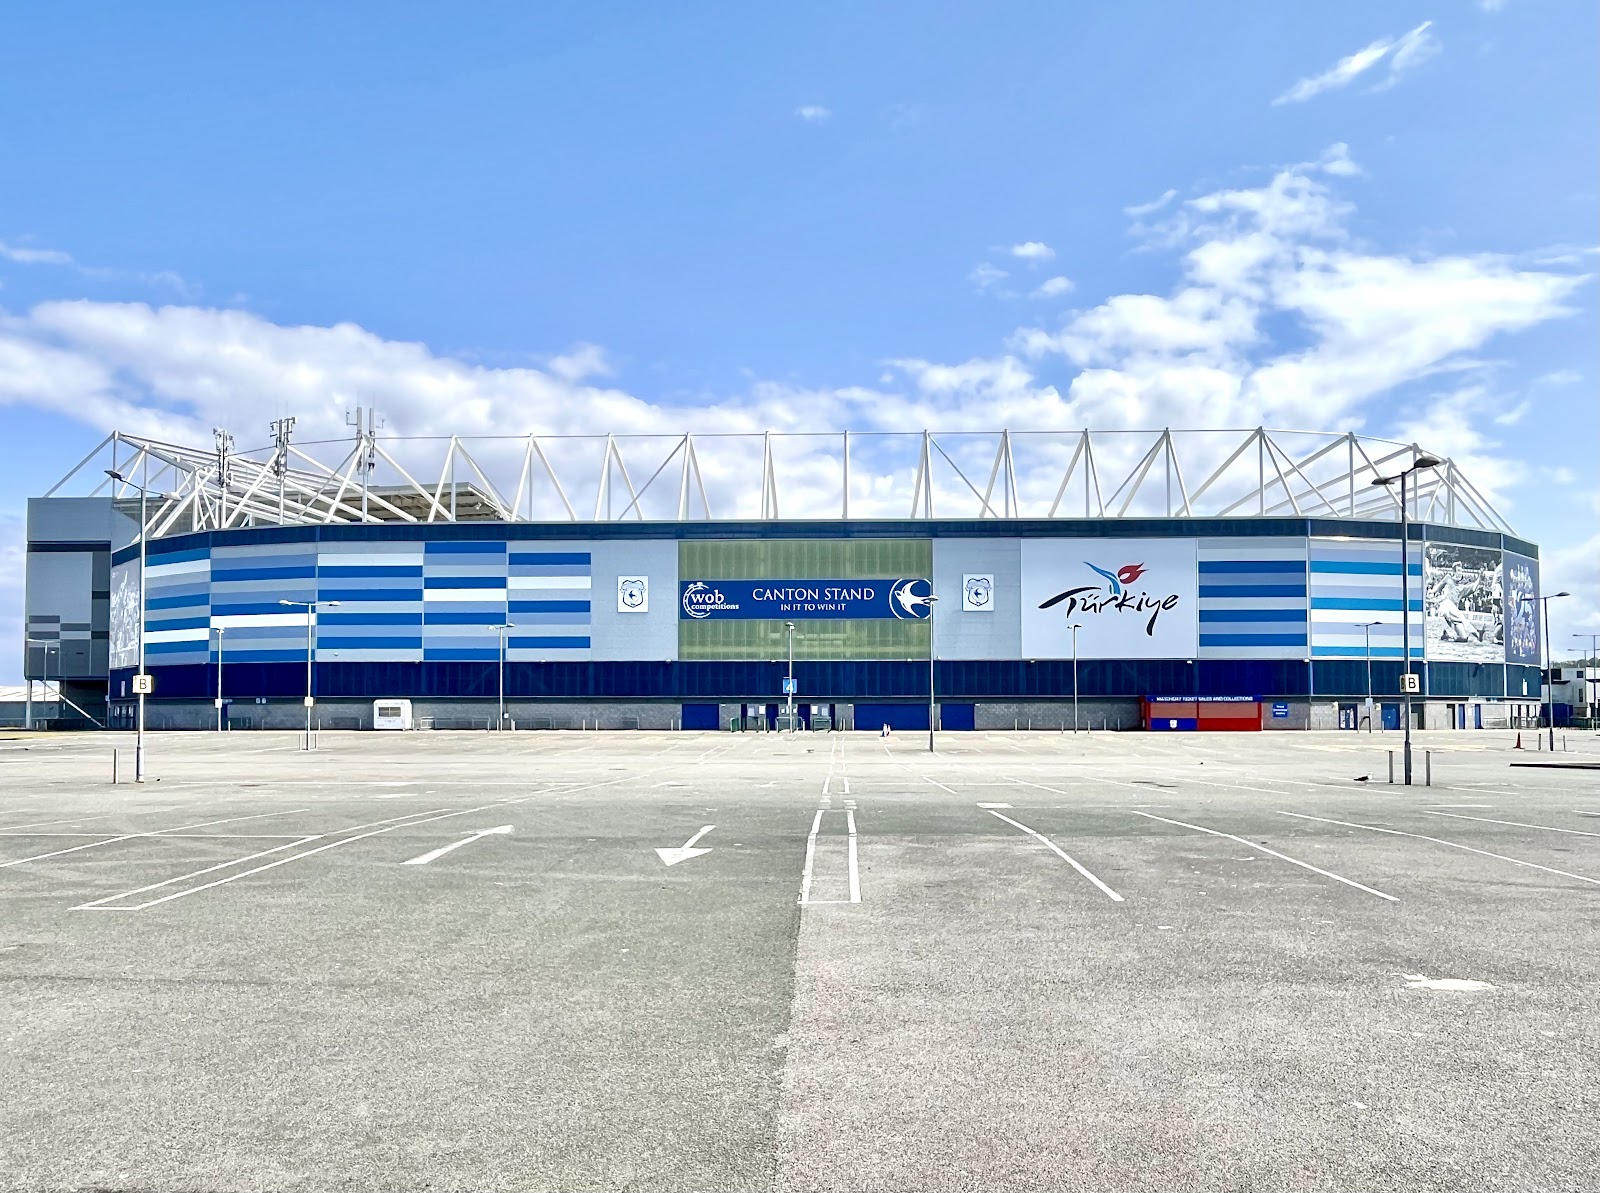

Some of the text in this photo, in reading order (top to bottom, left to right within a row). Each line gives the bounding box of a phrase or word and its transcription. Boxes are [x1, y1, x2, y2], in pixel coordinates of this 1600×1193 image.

[691, 589, 725, 603] wob
[752, 588, 875, 601] CANTON STAND
[691, 602, 740, 612] competitions
[780, 603, 847, 611] IN IT TO WIN IT
[1038, 586, 1180, 637] Türkiye
[139, 678, 147, 689] B
[1408, 677, 1416, 689] B
